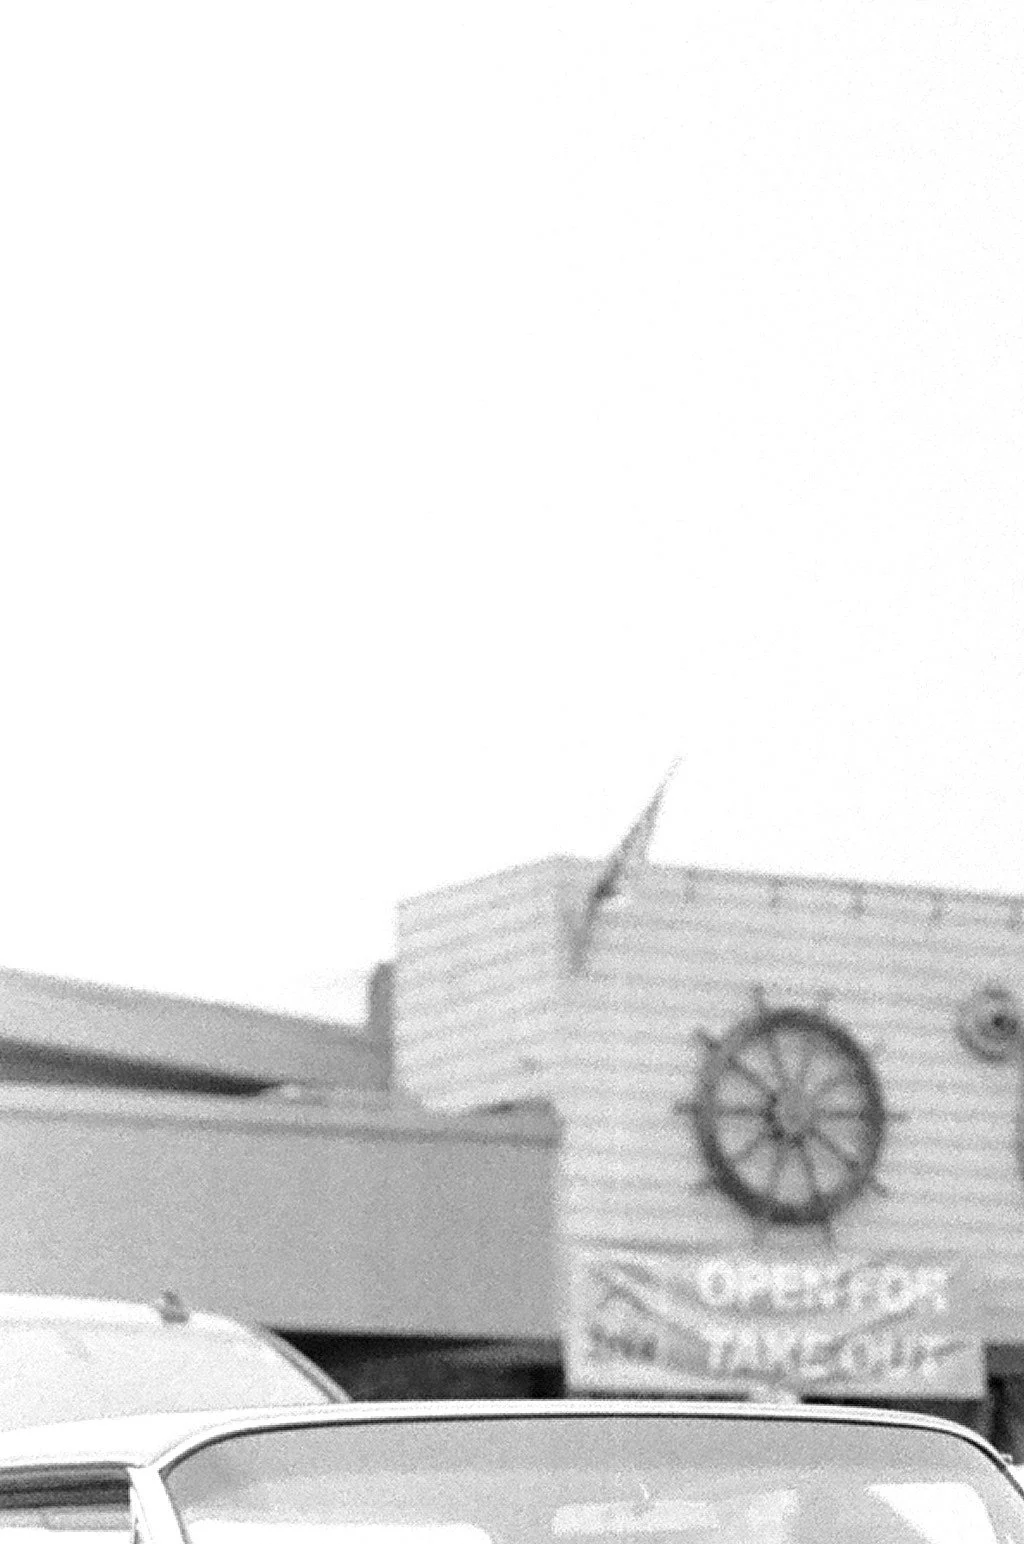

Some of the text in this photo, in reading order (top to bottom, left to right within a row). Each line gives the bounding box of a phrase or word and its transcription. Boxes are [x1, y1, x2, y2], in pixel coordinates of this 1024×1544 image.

[697, 1257, 949, 1314] OPEN FOR
[699, 1321, 957, 1383] TAKE OUT
